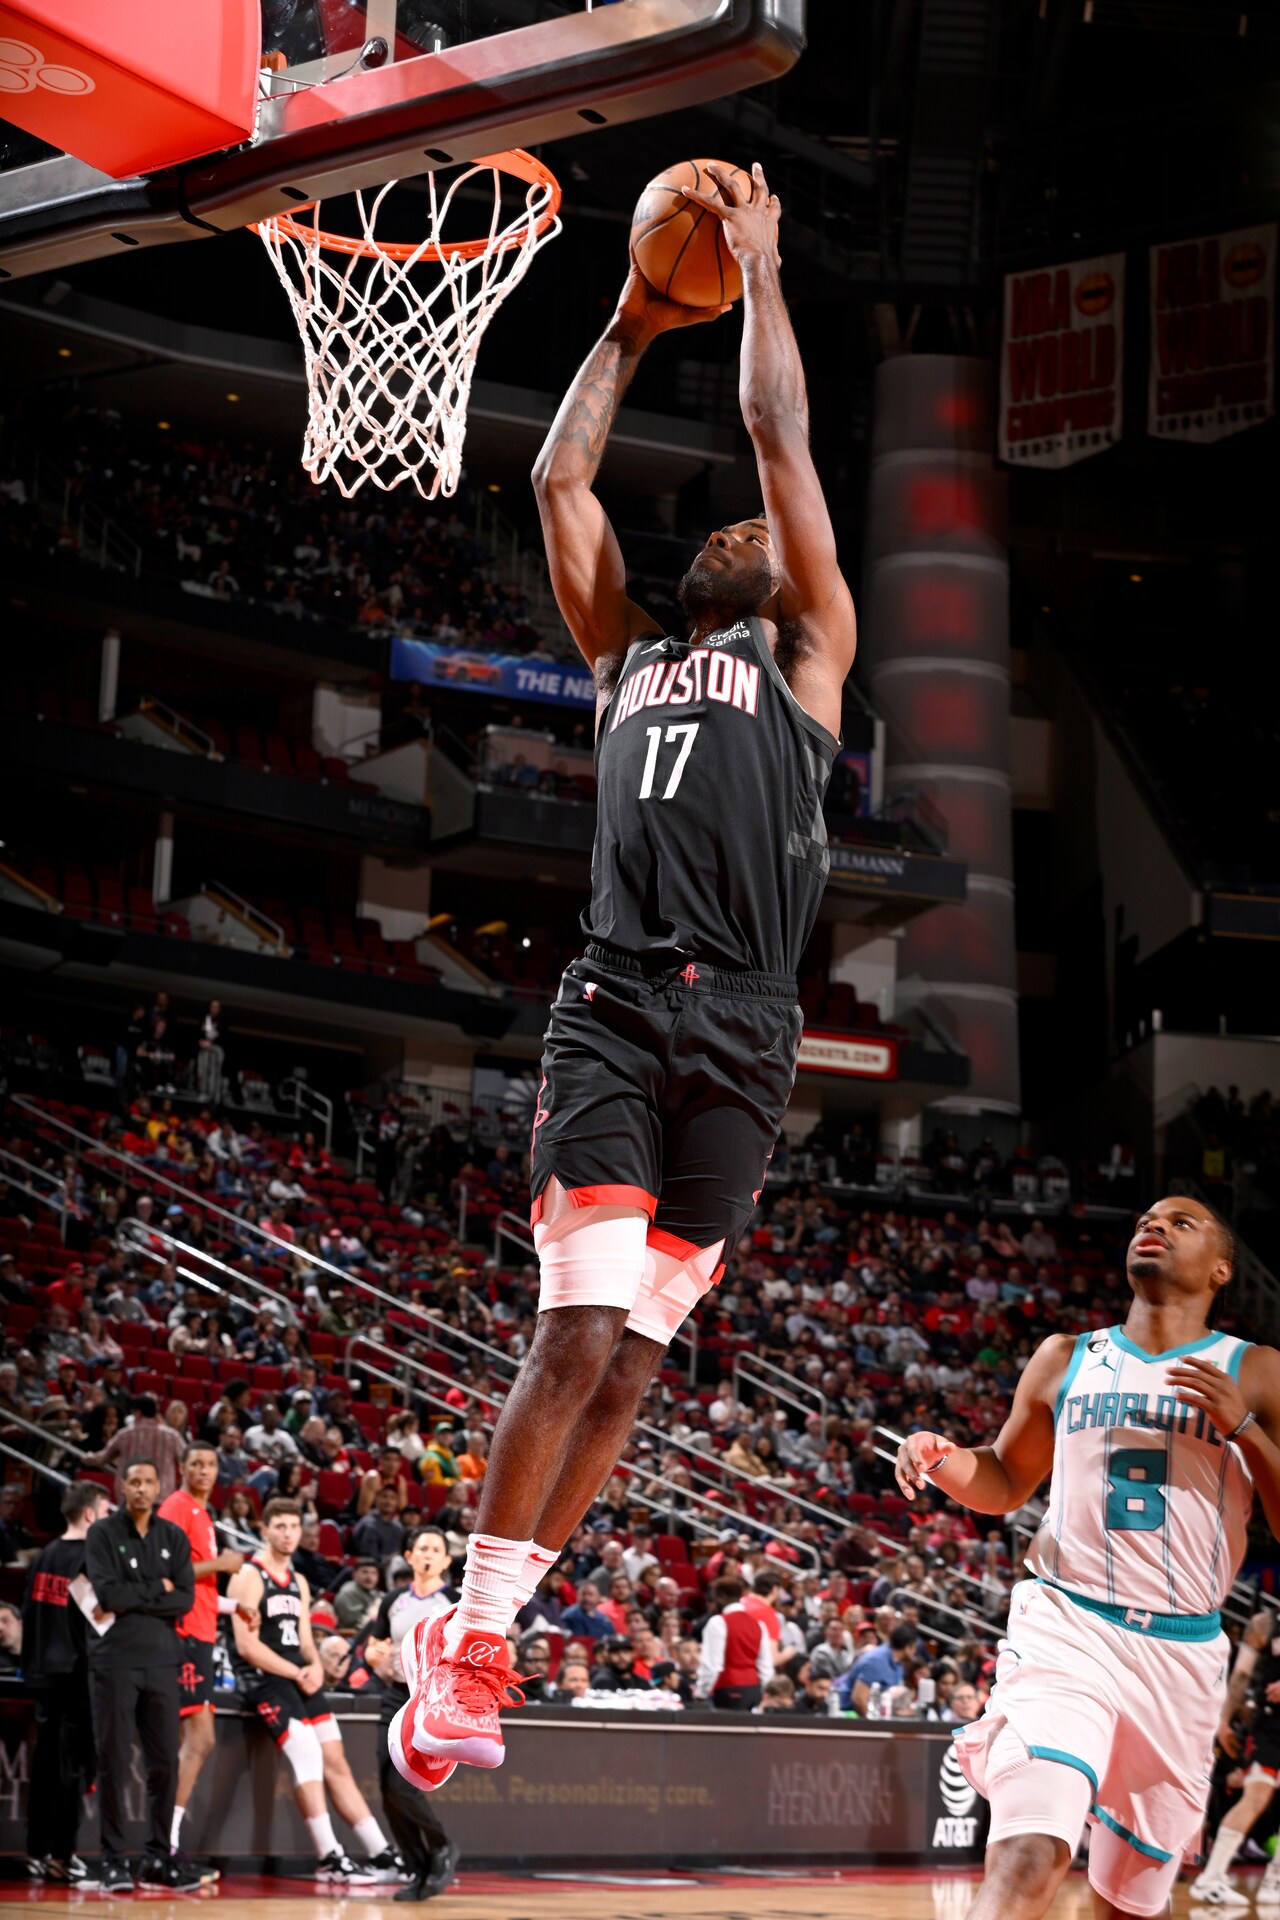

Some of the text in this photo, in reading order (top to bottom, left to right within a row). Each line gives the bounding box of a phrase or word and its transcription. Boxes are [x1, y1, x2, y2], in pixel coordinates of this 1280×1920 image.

[516, 667, 595, 700] THE NE
[609, 647, 762, 735] HOUSTON
[638, 722, 700, 800] 17
[829, 850, 905, 876] ERMANN
[1106, 1448, 1168, 1531] 8
[434, 1771, 714, 1813] ealth. Personalizing care.
[770, 1761, 894, 1796] MEMORIAL
[767, 1793, 893, 1826] HERMANN
[932, 1817, 978, 1848] AT&T
